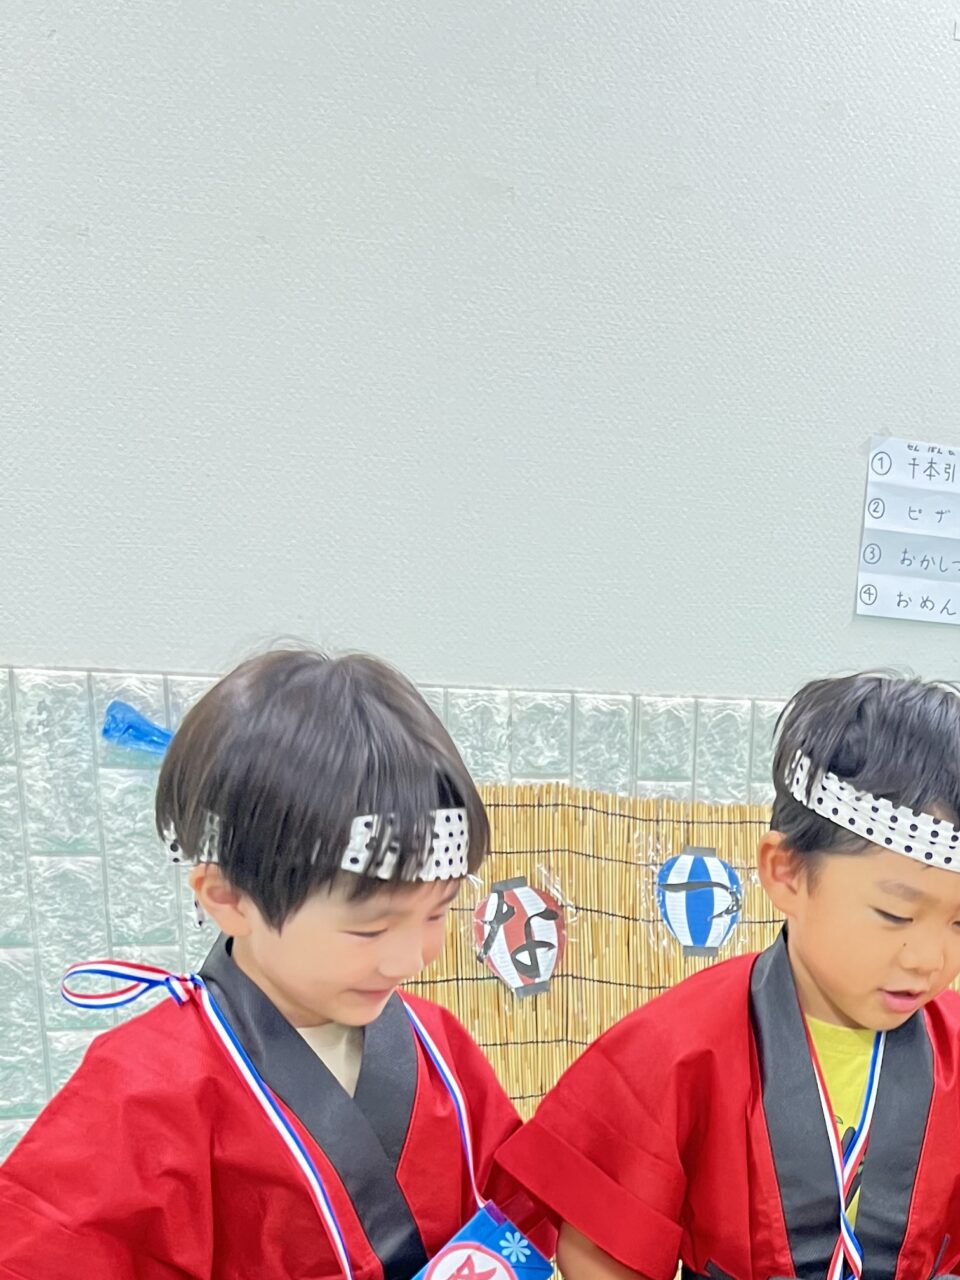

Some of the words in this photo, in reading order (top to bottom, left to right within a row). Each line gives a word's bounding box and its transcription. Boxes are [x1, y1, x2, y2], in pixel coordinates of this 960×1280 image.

[896, 591, 957, 617] おめん
[658, 880, 743, 920] つ
[476, 890, 559, 979] な
